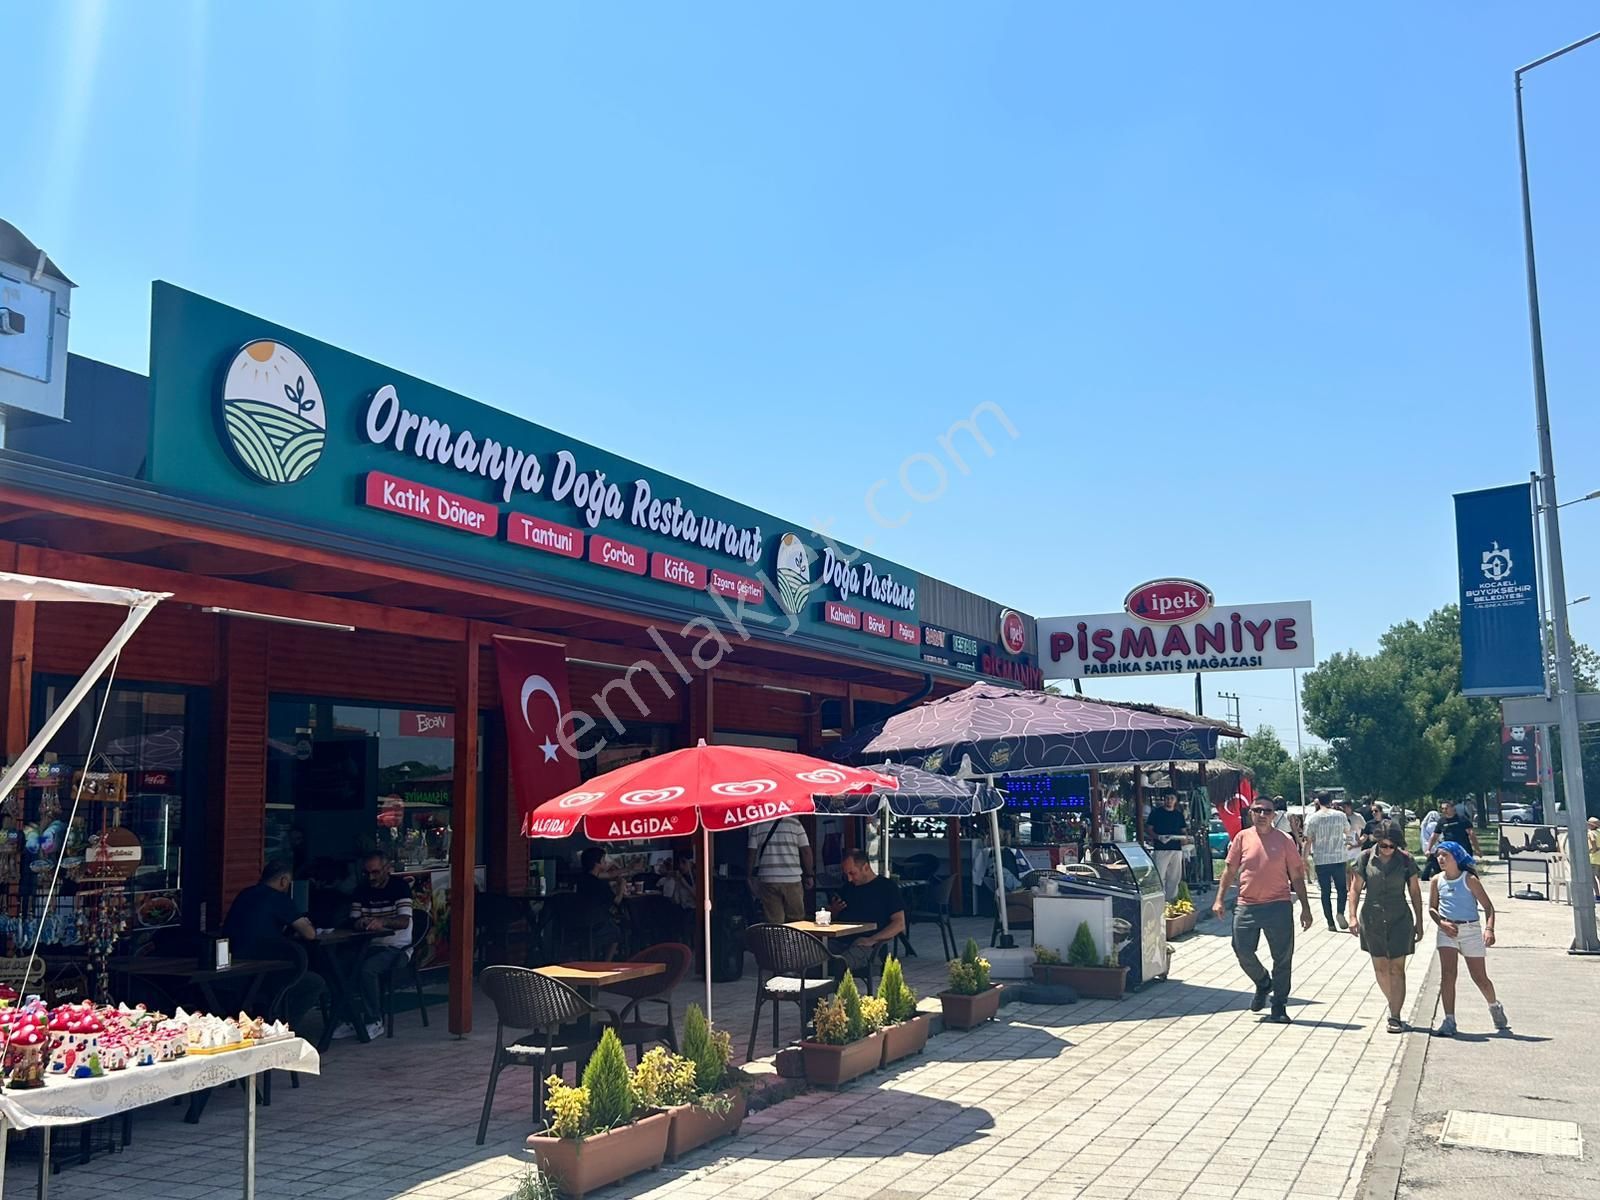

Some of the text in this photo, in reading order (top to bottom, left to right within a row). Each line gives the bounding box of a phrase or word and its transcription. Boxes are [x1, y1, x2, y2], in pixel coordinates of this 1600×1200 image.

[366, 384, 762, 562] Ormanya Doğa Restaurant
[384, 480, 485, 530] Katık Döner
[521, 519, 573, 551] Tantuni
[602, 542, 635, 567] Çorba
[664, 558, 695, 585] Köfte
[823, 547, 915, 611] Doğa Pastane
[1152, 591, 1199, 614] ipek
[868, 616, 886, 634] Börek
[1050, 612, 1298, 662] PİŞMANİYE
[1084, 654, 1263, 675] FABRİKA SATIŞ MAĞAZASI
